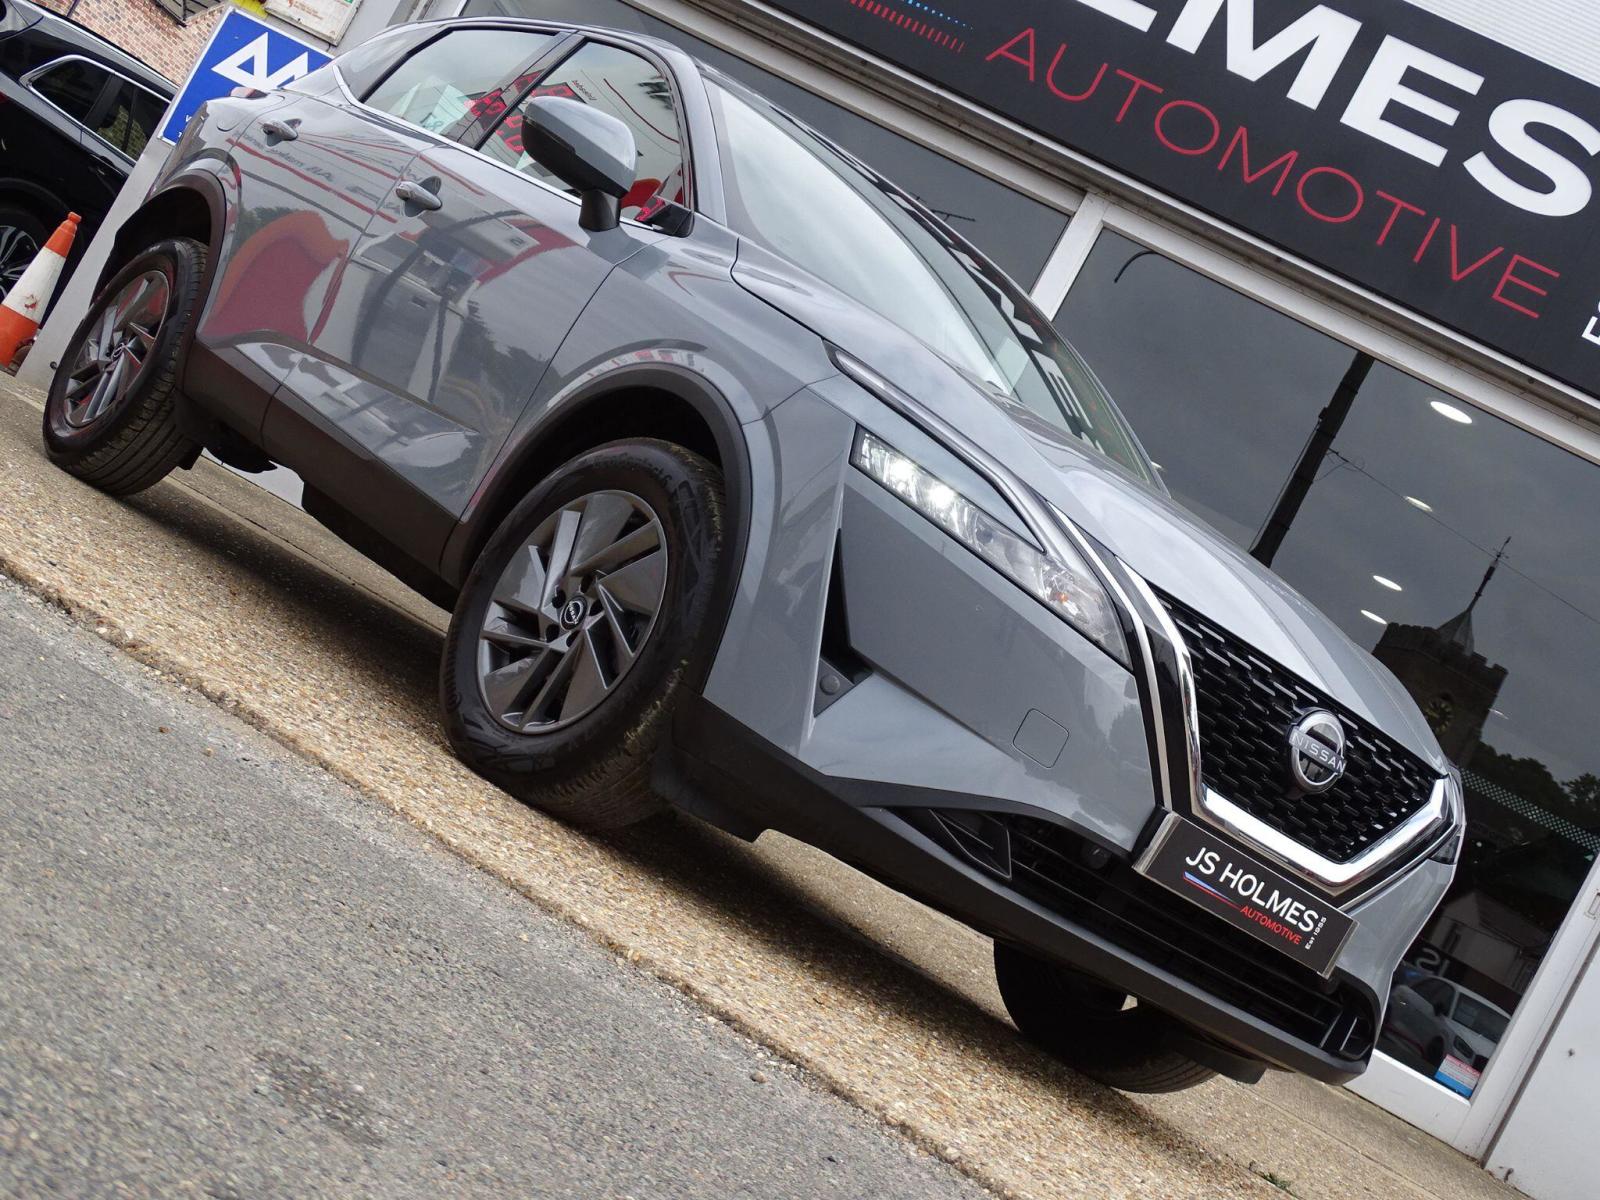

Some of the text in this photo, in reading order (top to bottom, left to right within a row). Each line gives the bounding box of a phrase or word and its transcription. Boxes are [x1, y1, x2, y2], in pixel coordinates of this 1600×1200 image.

[985, 27, 1560, 319] AUTOMOTIVE
[1291, 731, 1346, 773] NISSAN
[1185, 847, 1319, 932] JS HOLMES
[1240, 905, 1302, 945] AUTOMOTIVE
[1313, 916, 1328, 936] 1955
